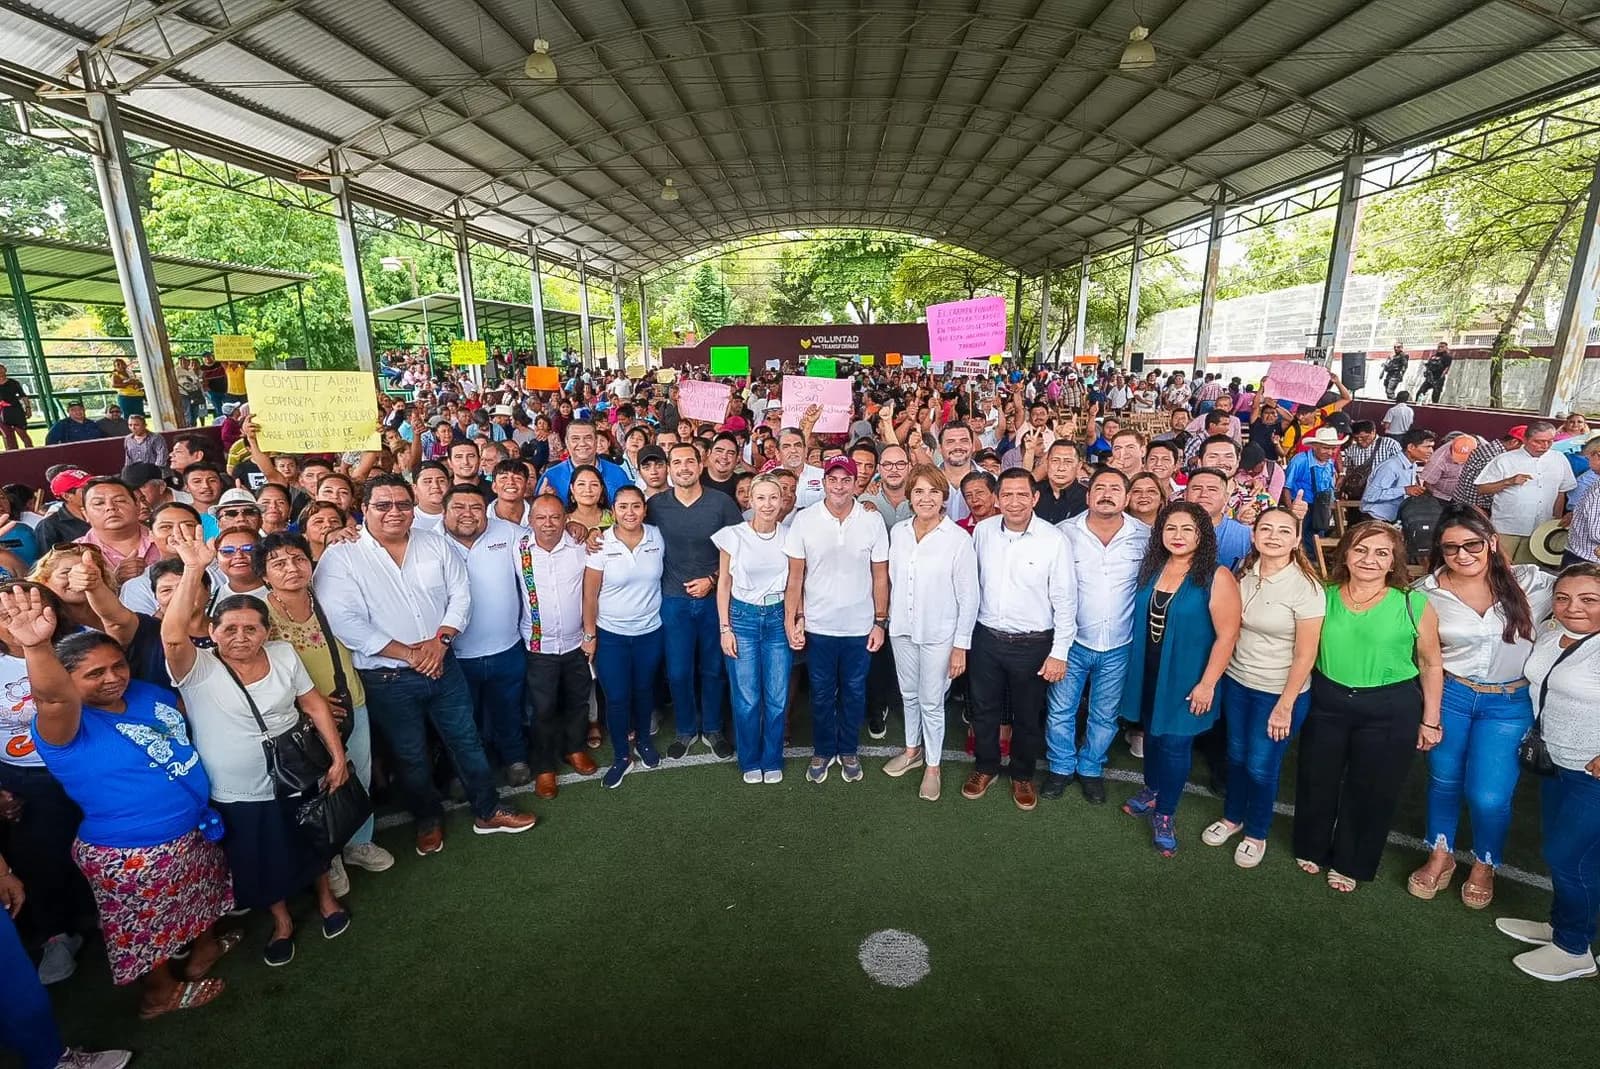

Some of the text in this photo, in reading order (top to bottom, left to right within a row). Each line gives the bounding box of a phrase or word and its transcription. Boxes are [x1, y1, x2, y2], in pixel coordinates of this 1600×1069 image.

[811, 335, 860, 344] VOLUNTAD
[1304, 348, 1327, 359] FALTAS
[262, 374, 322, 392] COMITE
